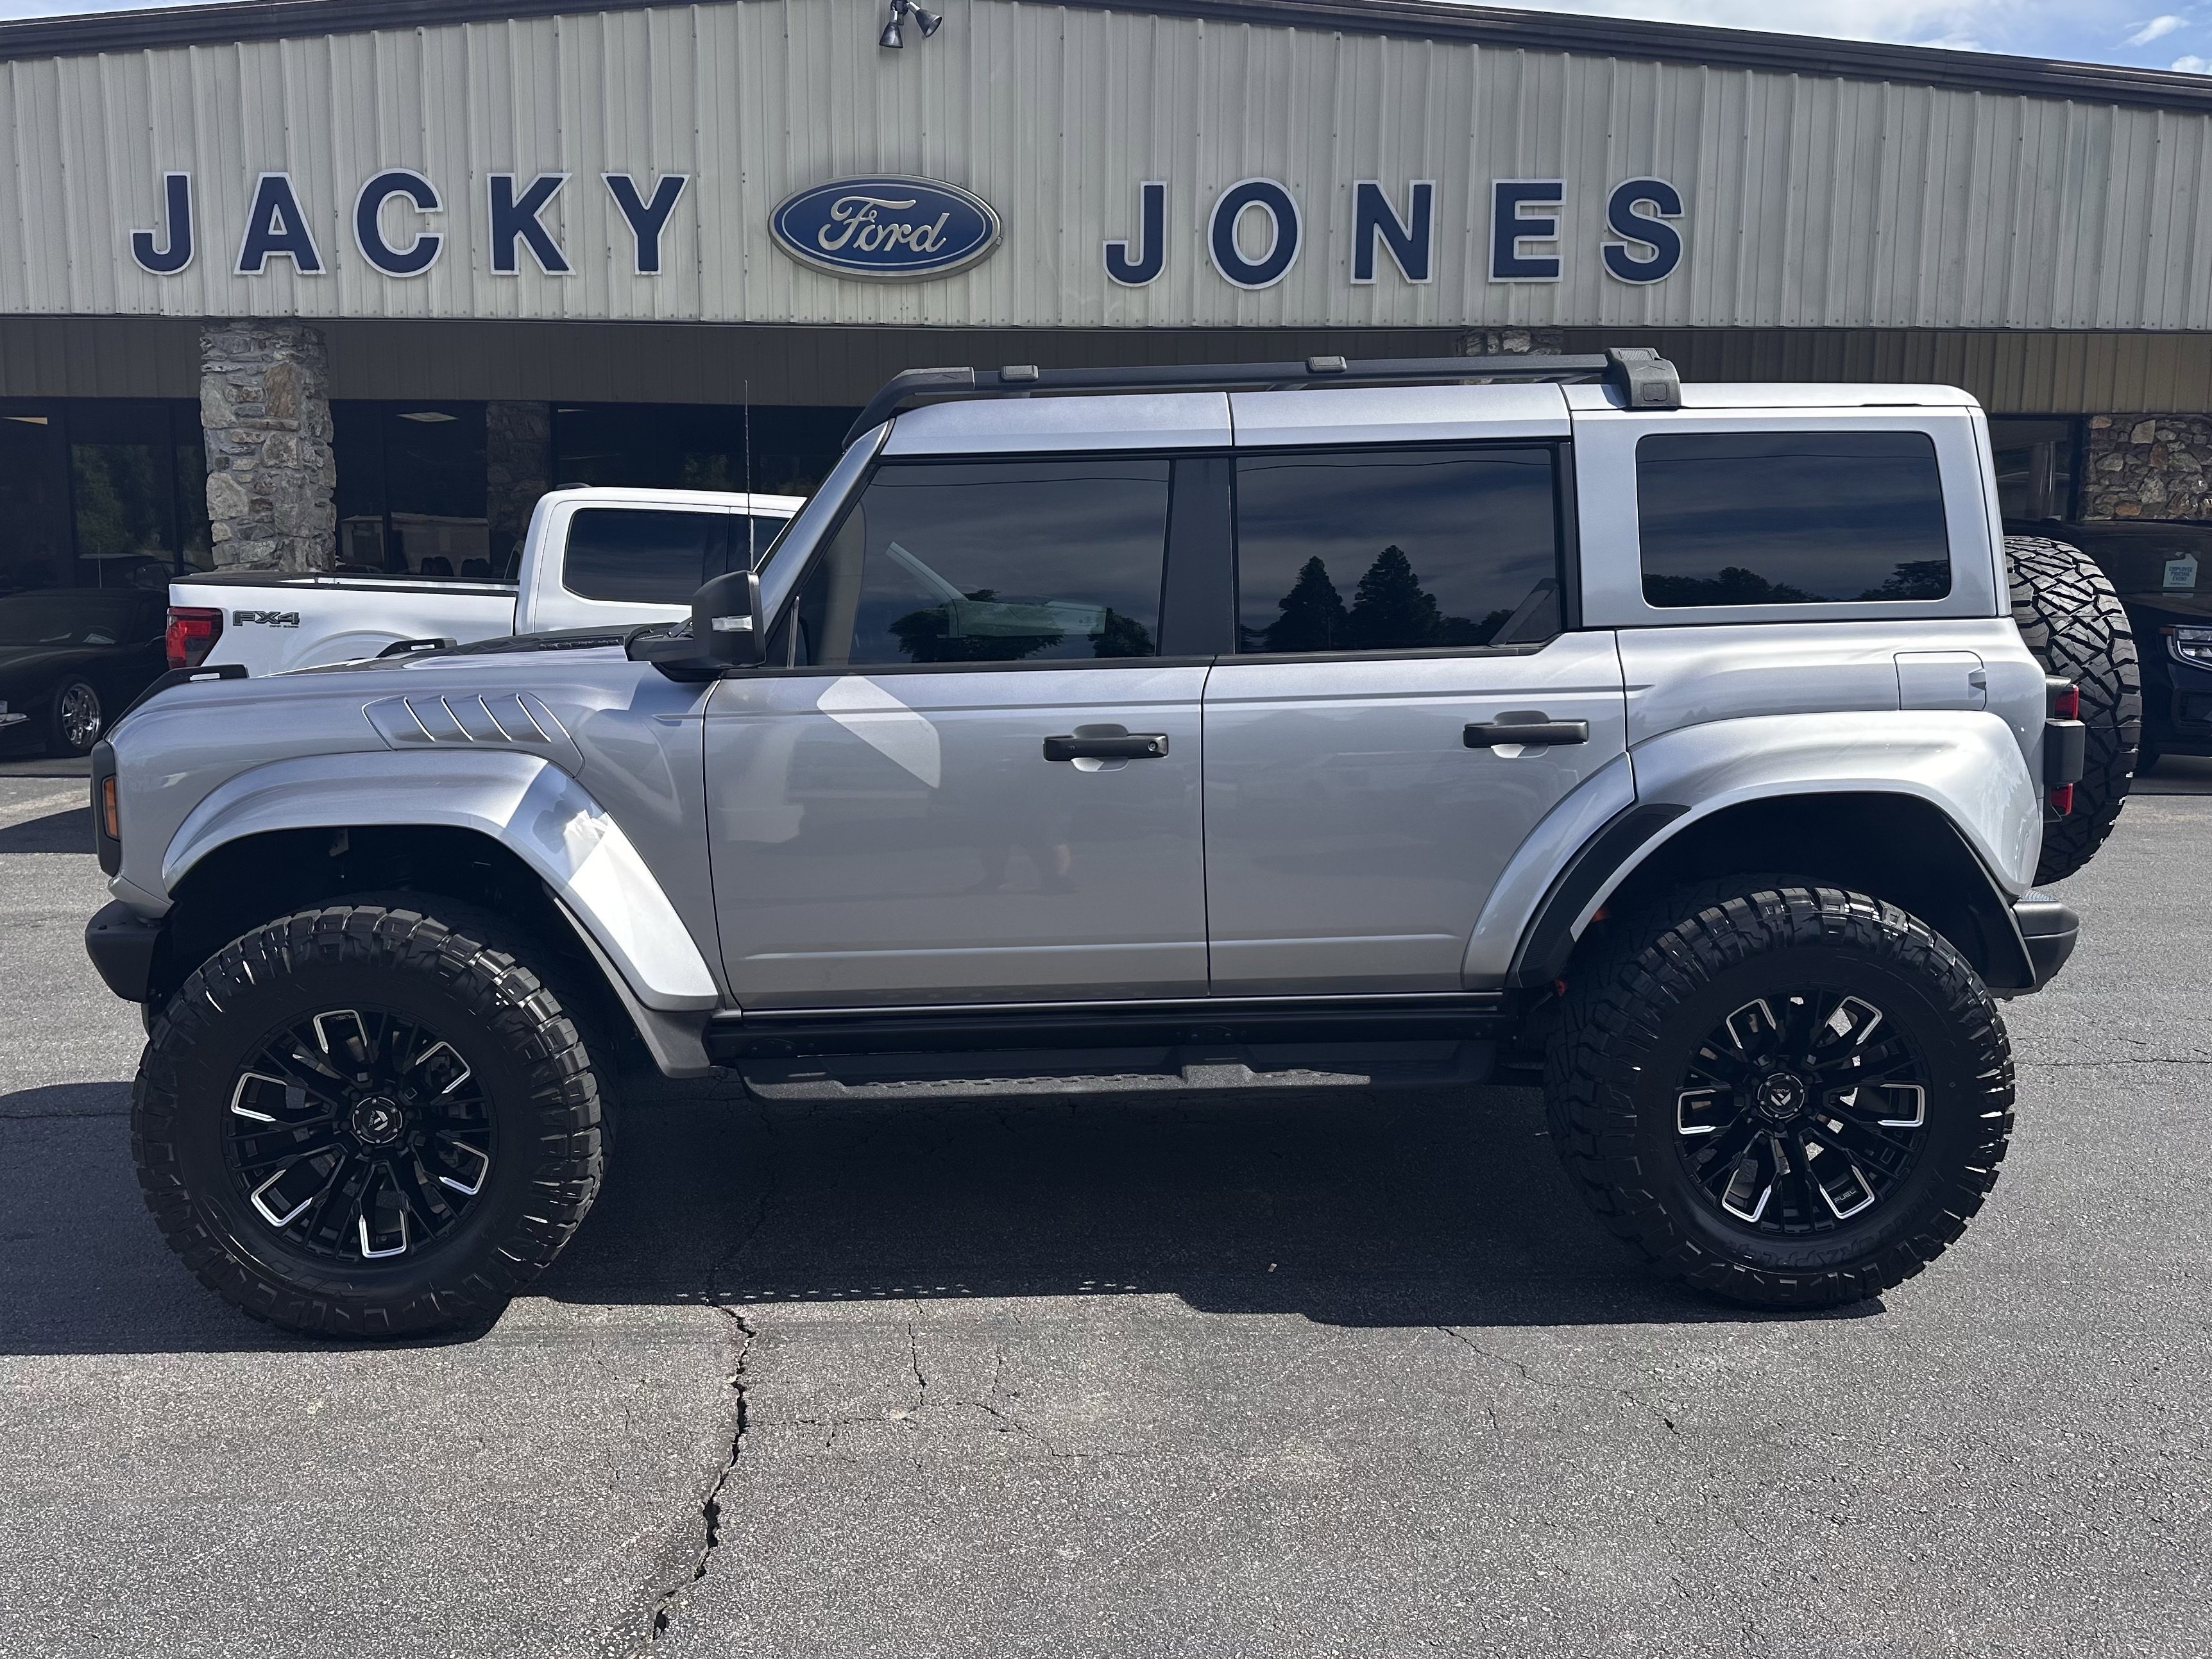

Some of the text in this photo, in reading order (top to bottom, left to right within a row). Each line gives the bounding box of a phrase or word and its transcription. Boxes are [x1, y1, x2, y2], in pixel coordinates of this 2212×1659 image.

[130, 168, 1684, 290] JACKY Ford JONES
[233, 611, 300, 626] FX4
[1833, 1190, 1857, 1204] FUEL
